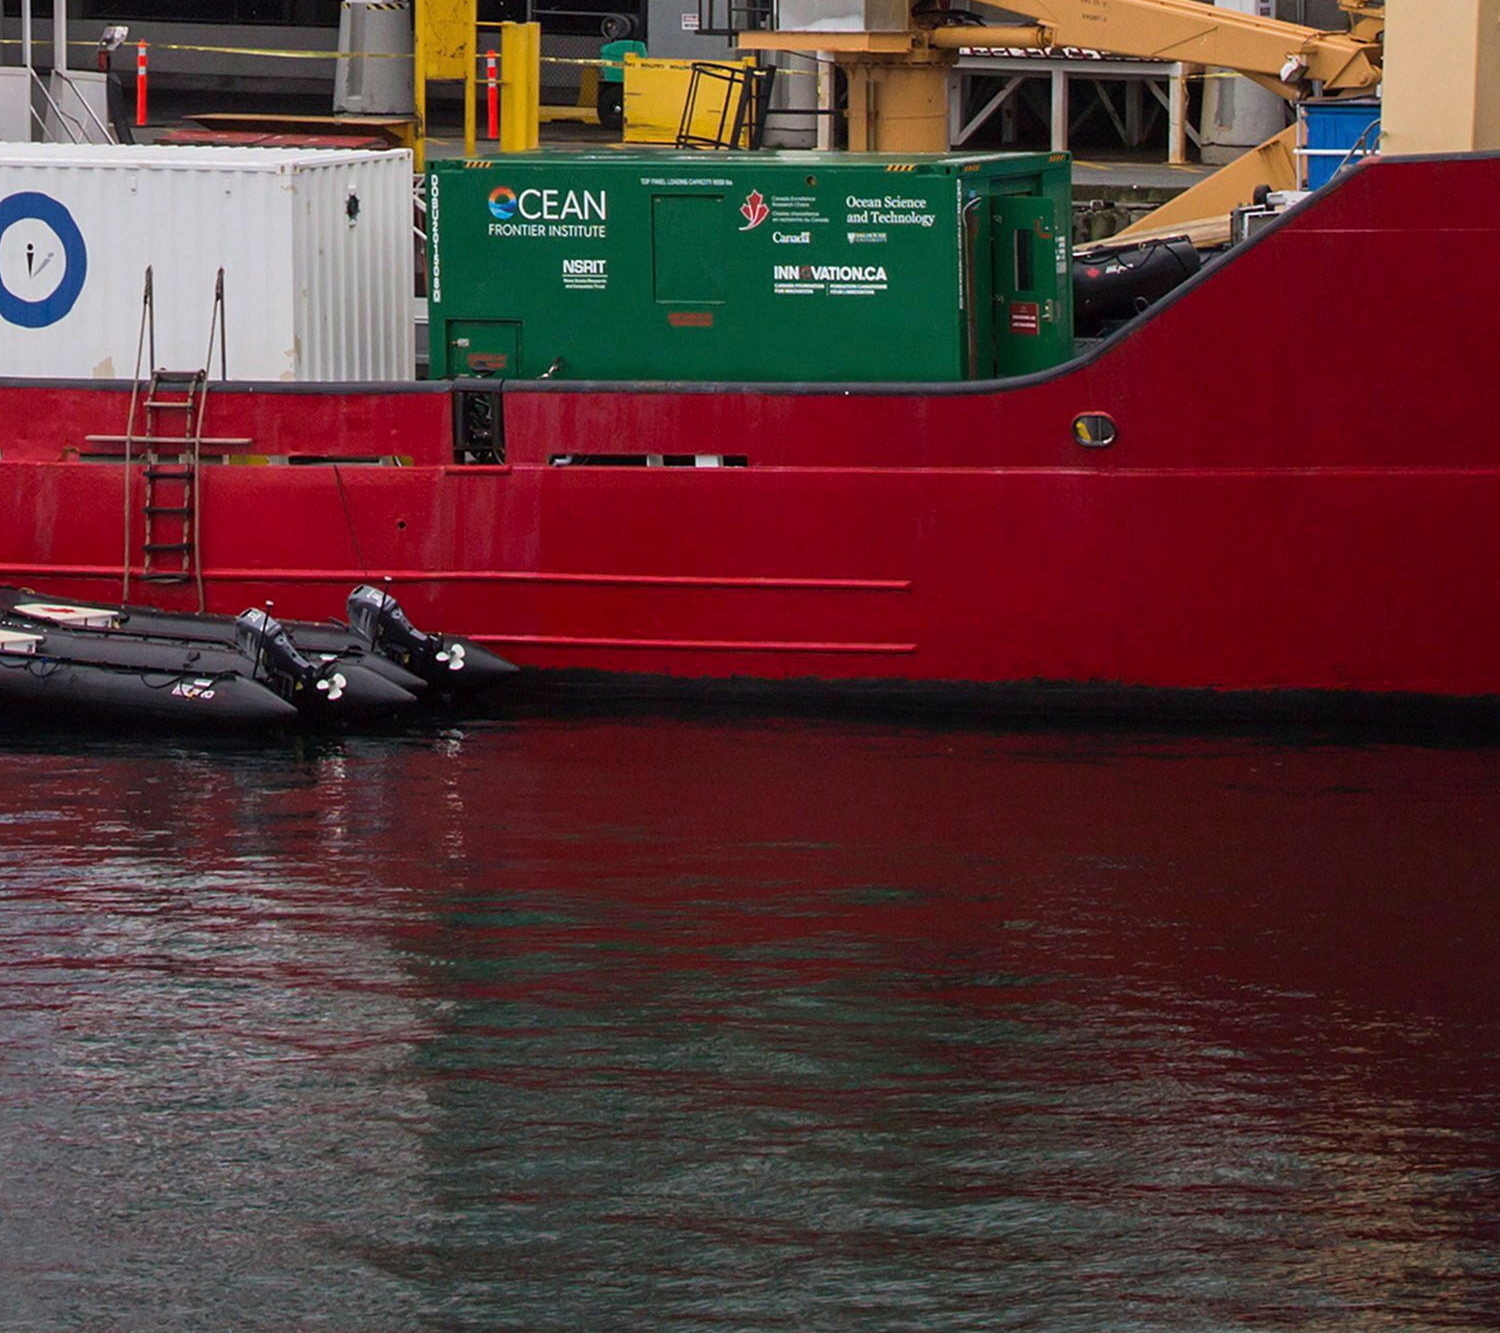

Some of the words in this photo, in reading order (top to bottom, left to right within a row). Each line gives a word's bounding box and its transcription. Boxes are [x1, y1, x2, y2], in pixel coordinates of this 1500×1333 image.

[488, 186, 606, 220] OCEAN
[846, 196, 882, 209] Ocean
[884, 195, 927, 209] Science
[847, 211, 868, 224] and
[870, 211, 936, 227] Technology
[488, 223, 545, 237] FRONTIER
[548, 224, 606, 238] INSTITUTE
[772, 232, 810, 244] Canada
[563, 259, 606, 274] NSRIT
